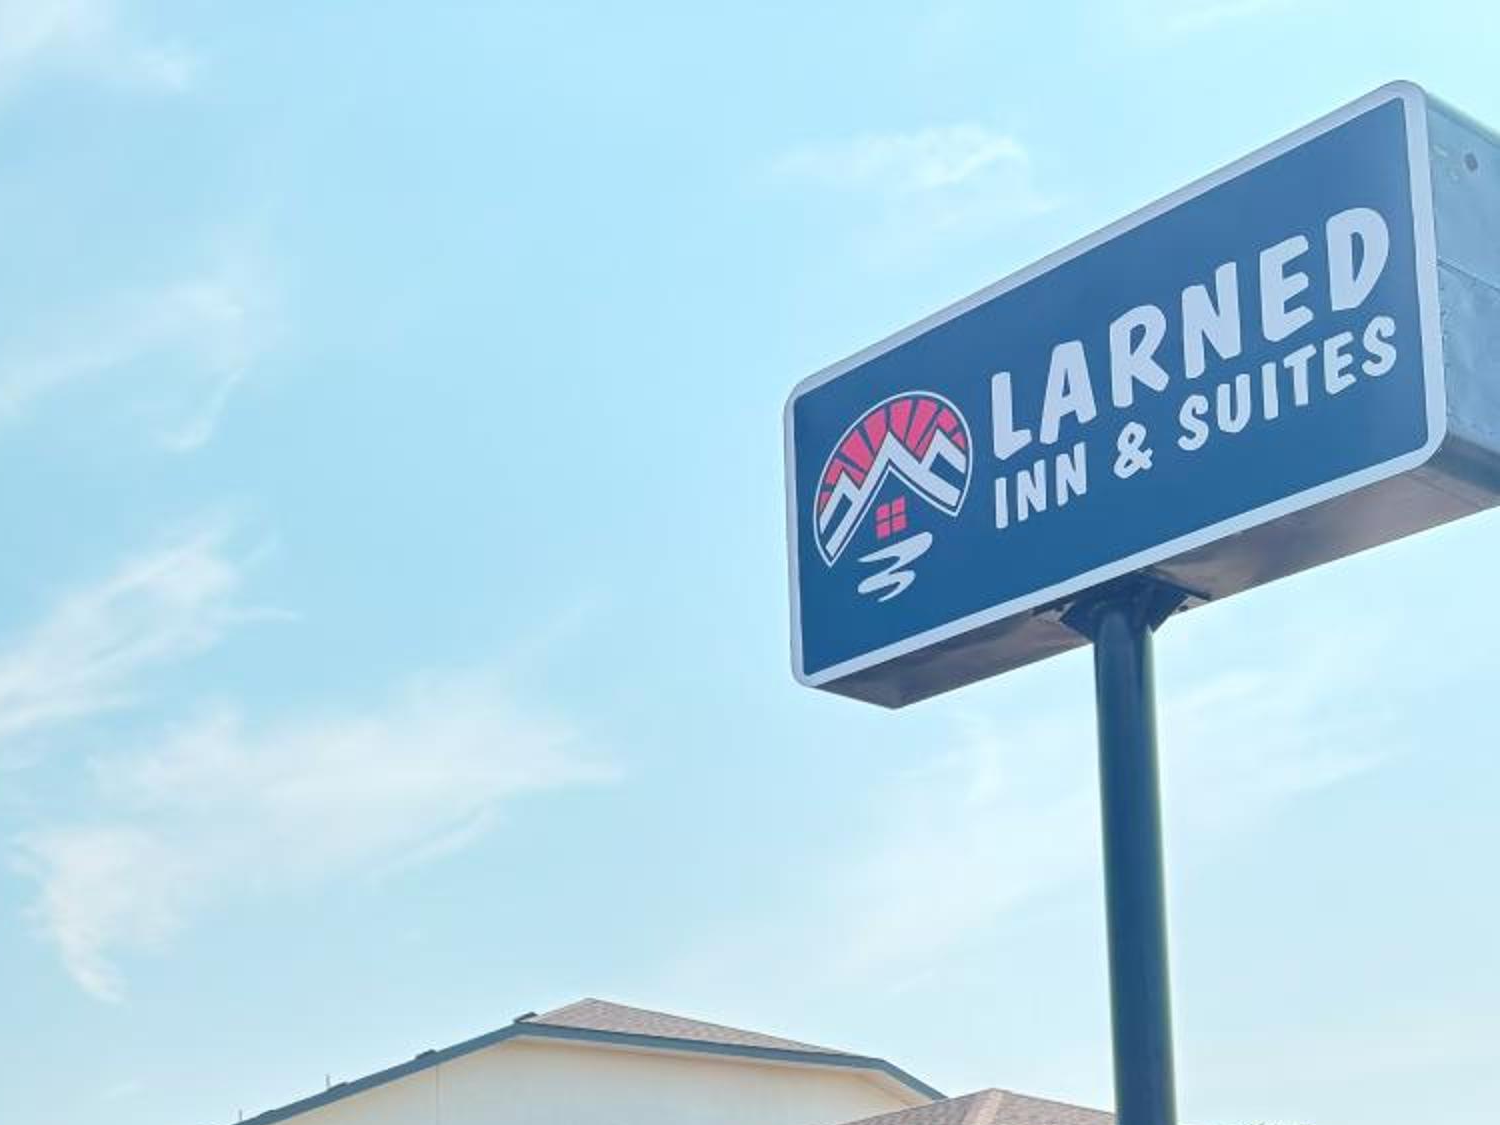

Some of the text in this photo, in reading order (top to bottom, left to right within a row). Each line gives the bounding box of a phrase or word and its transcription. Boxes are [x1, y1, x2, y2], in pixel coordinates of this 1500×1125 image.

[991, 207, 1390, 461] LARNED
[994, 315, 1398, 529] INN & SUITES
